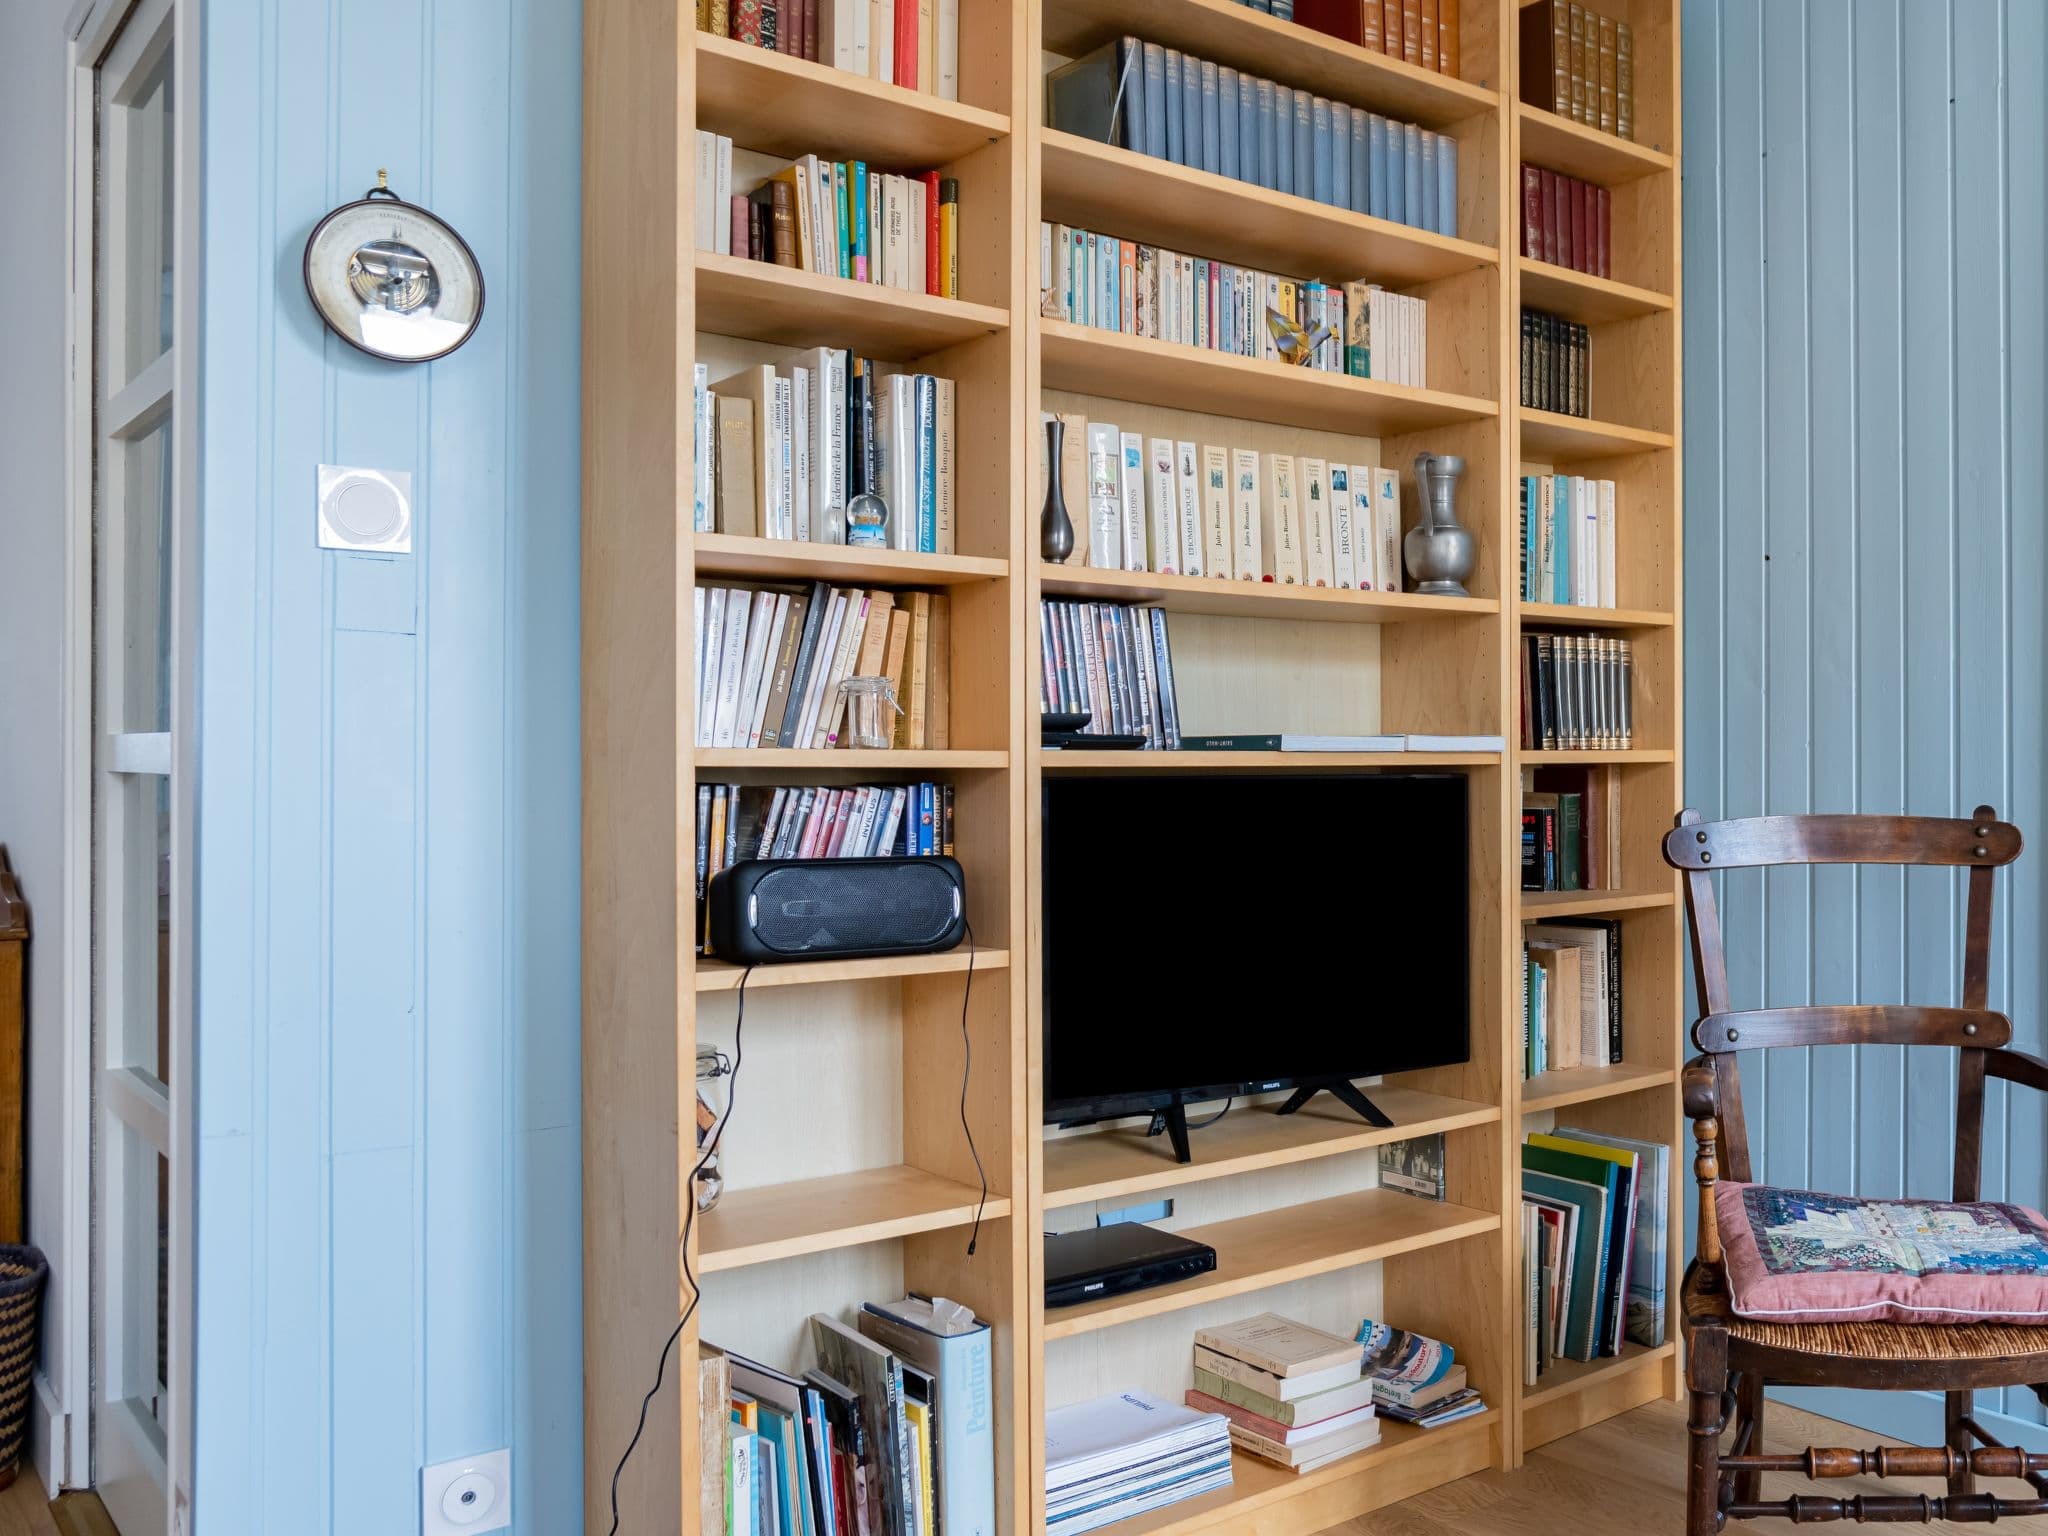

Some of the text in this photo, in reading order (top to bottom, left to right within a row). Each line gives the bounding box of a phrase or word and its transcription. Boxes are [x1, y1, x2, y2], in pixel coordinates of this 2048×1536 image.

[831, 403, 842, 510] L'identité de la France
[940, 429, 951, 473] Bonaparte
[1130, 489, 1139, 525] JARDINS
[940, 520, 948, 531] La
[861, 797, 878, 838] INVICTUS
[933, 793, 941, 833] TORINO
[1262, 1082, 1280, 1090] PHILIPS
[1084, 1282, 1104, 1292] PHILIPS
[1120, 1394, 1154, 1411] PHILIPS
